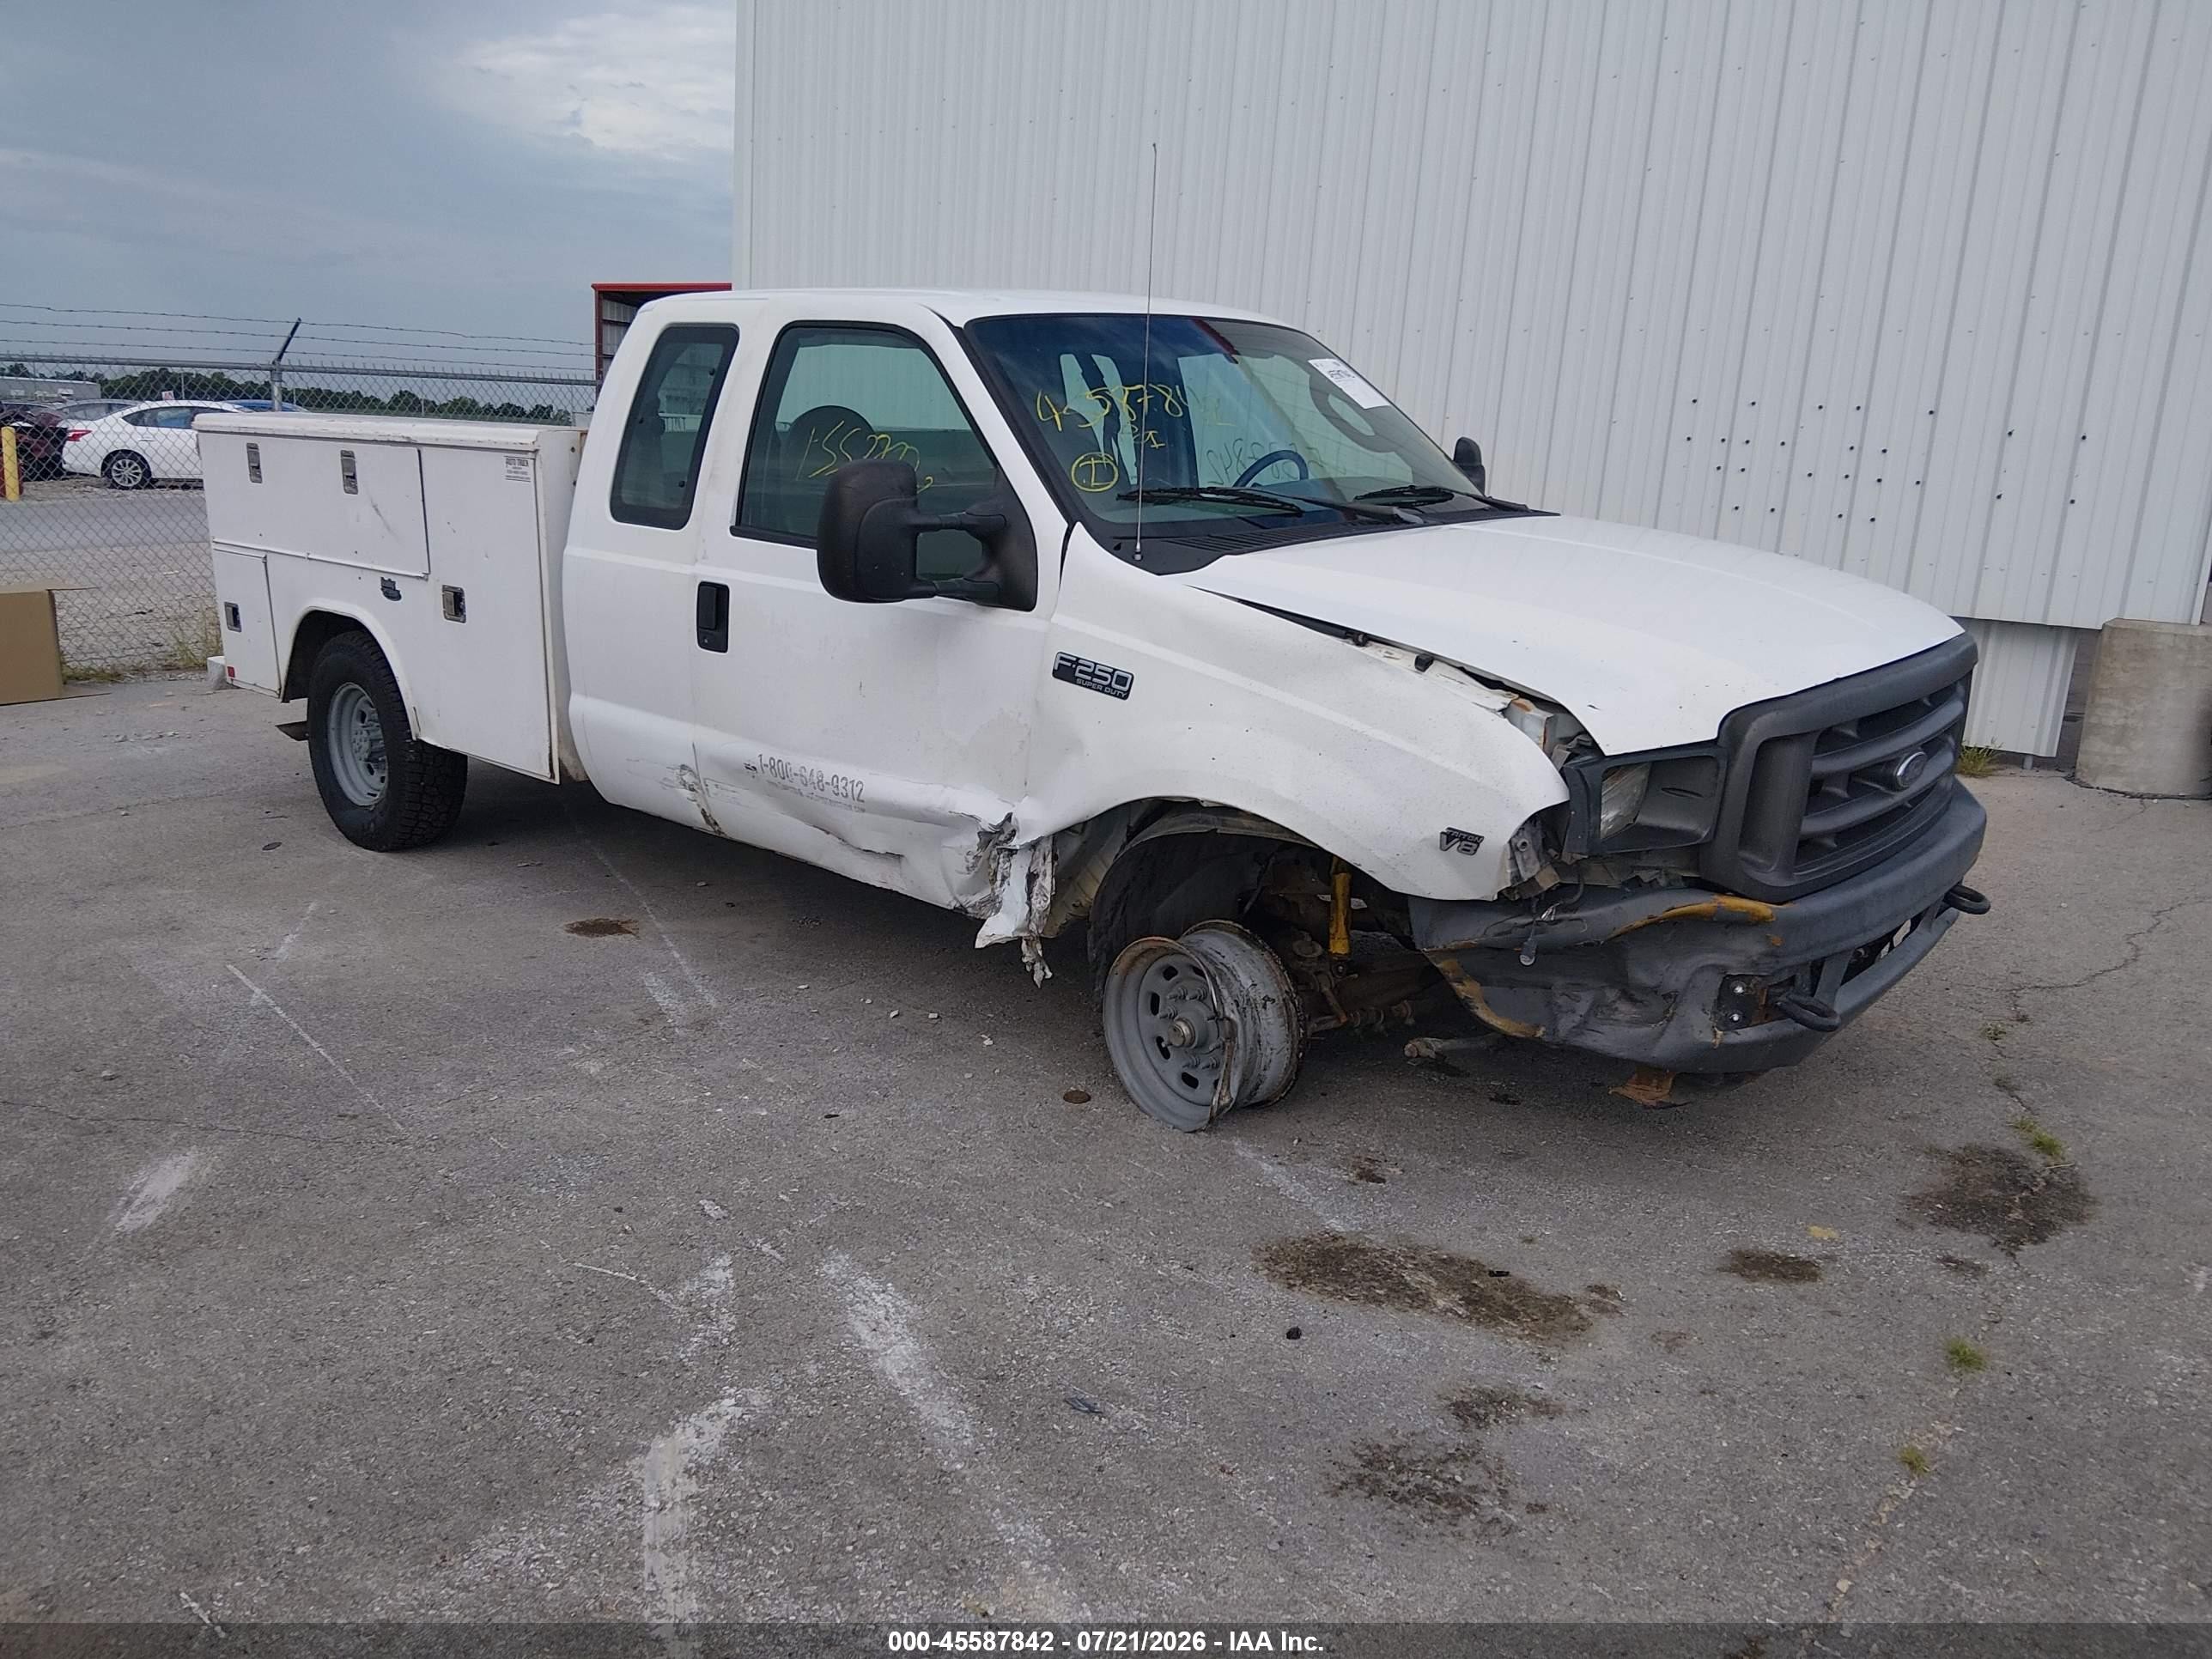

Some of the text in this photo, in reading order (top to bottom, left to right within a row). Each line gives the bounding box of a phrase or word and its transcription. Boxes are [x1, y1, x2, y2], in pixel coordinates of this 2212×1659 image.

[1076, 678, 1128, 699] SUPER DUTY
[1440, 831, 1480, 856] V8
